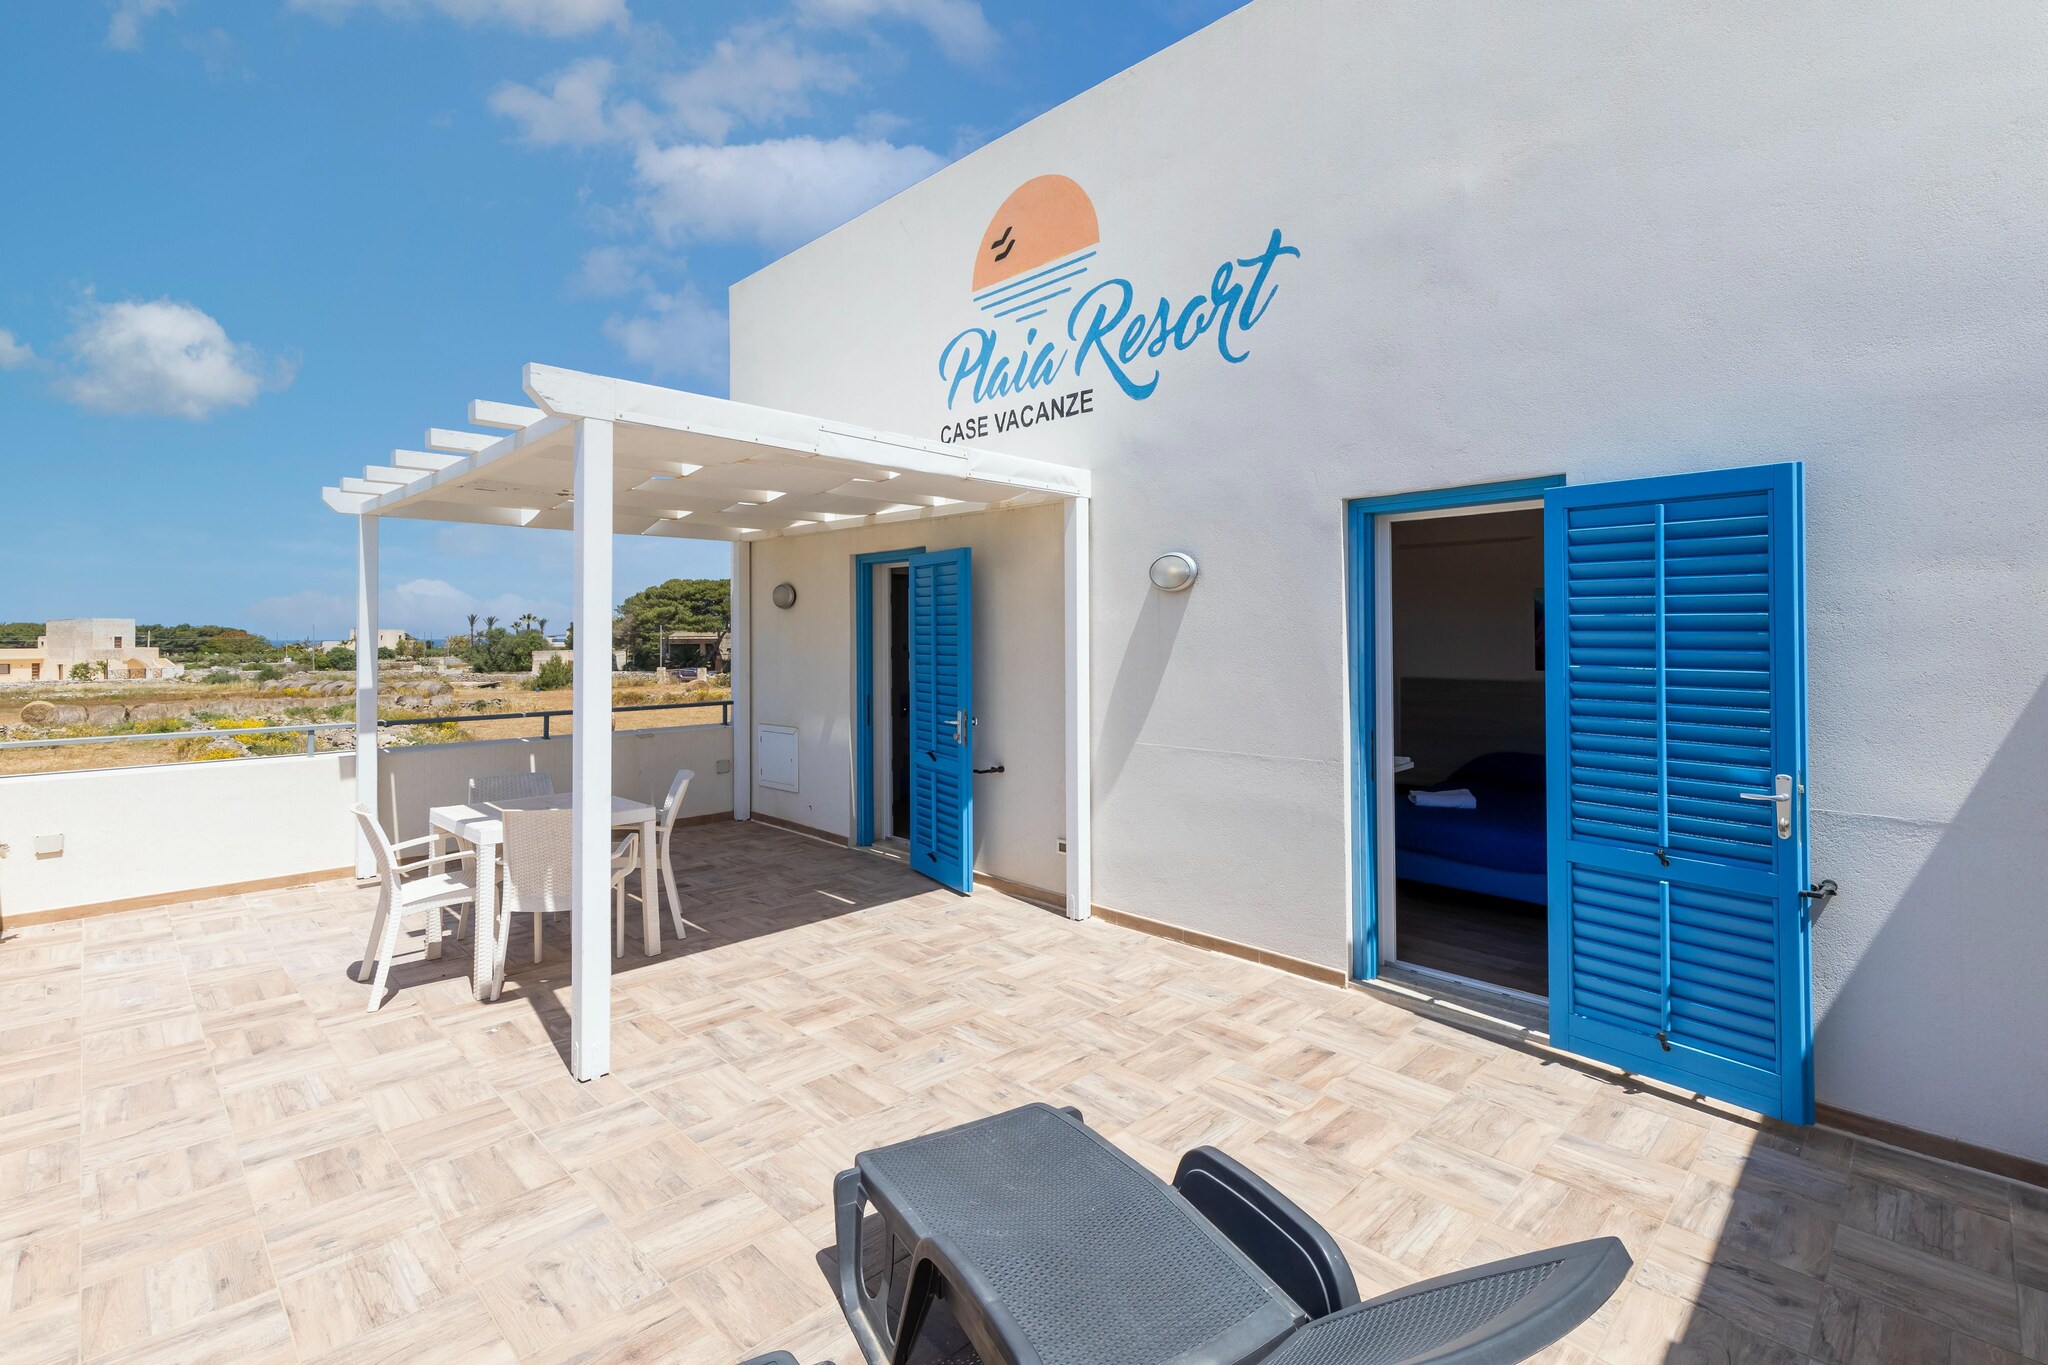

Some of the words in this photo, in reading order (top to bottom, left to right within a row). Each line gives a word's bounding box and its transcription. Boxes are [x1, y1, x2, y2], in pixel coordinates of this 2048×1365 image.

[938, 327, 1068, 410] Plaia
[1067, 228, 1301, 400] Resort
[940, 413, 989, 444] CASE
[994, 388, 1094, 434] VACANZE
